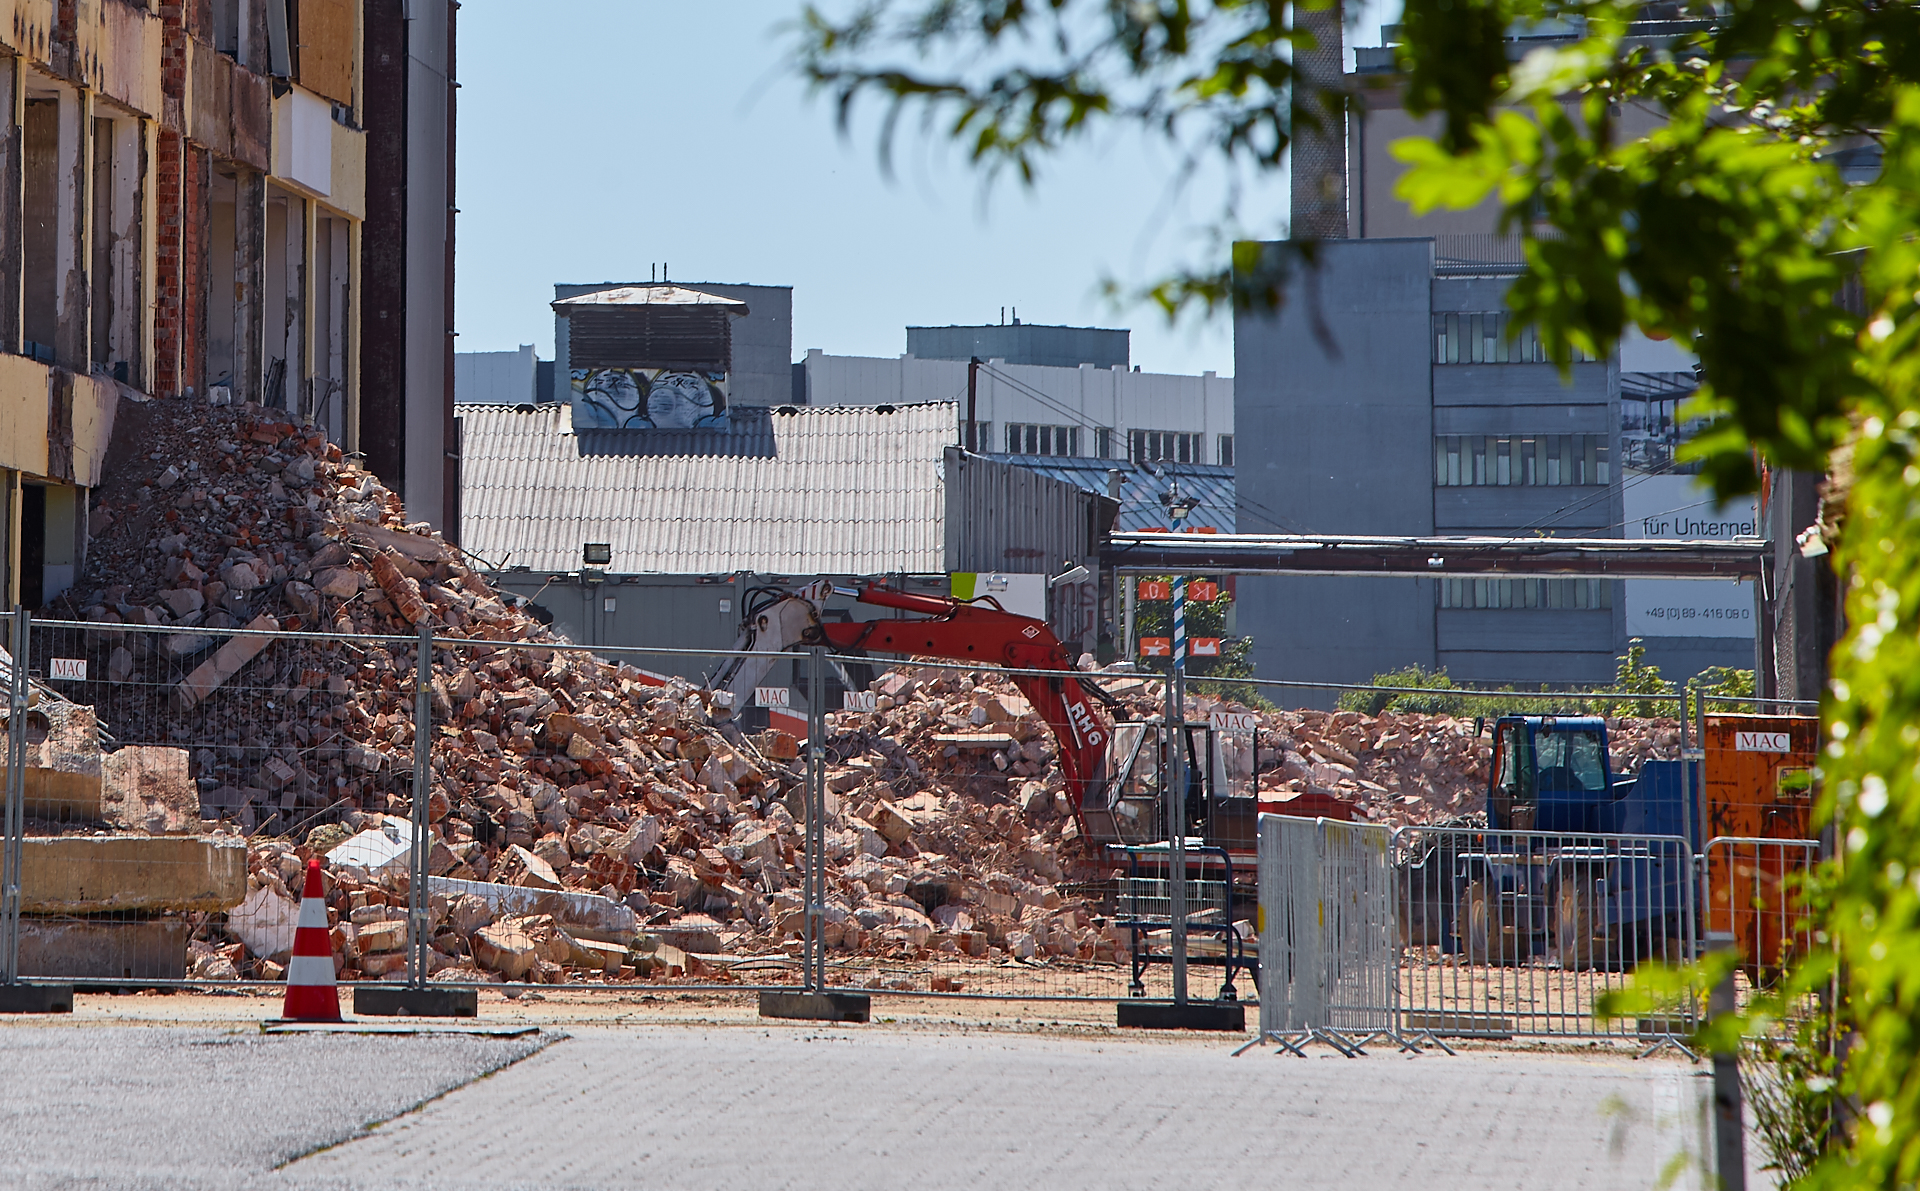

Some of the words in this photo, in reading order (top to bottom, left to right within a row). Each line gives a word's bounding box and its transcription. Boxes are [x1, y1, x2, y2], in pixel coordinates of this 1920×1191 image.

[1643, 517, 1670, 536] für
[1645, 607, 1665, 619] +49
[1682, 607, 1696, 619] 89
[1702, 607, 1723, 620] 416
[1725, 608, 1740, 620] 08
[1741, 608, 1750, 620] 0
[54, 659, 85, 677] MAC
[759, 688, 788, 706] MAC
[1215, 713, 1252, 730] MAC
[1741, 733, 1786, 749] MAC
